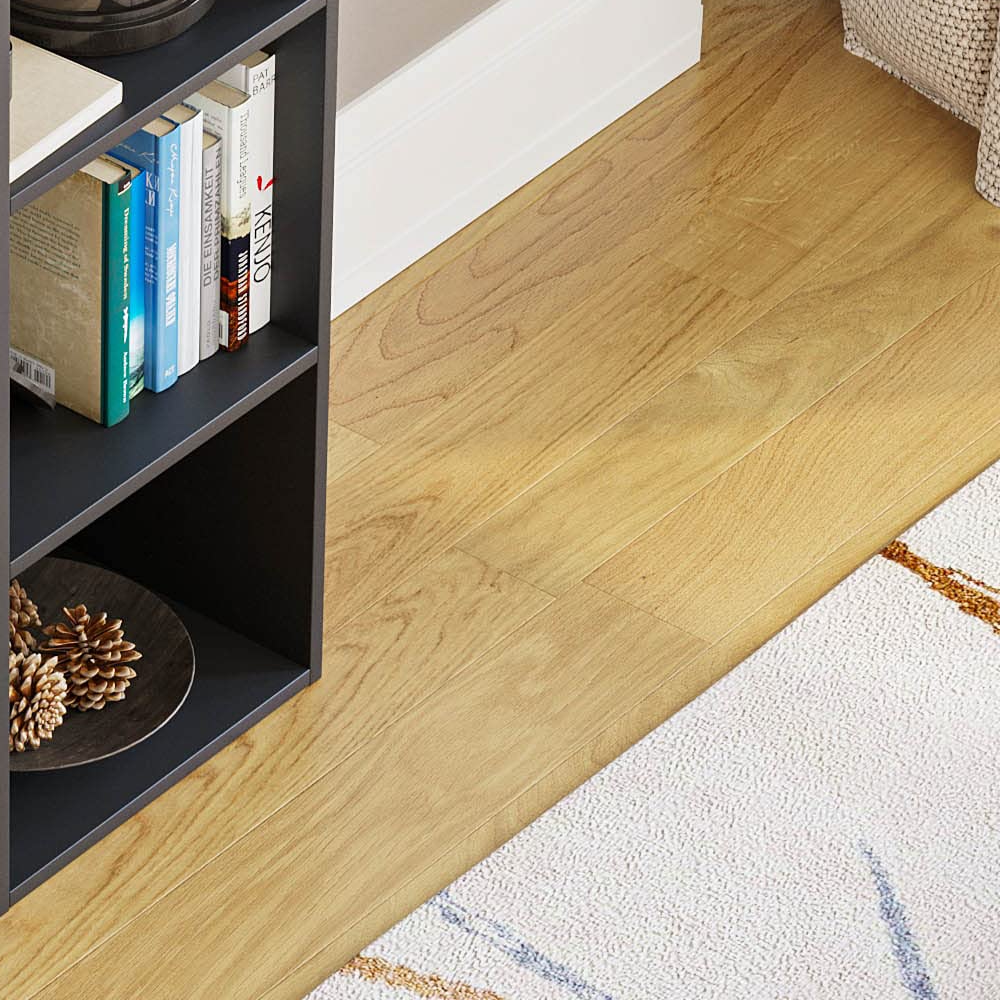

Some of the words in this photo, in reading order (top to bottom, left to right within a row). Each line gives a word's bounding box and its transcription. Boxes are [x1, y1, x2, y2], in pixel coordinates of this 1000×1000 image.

[253, 68, 269, 84] PAT
[203, 167, 214, 259] EINSAMKEIT
[253, 204, 272, 283] KENJO
[203, 260, 212, 288] DIE
